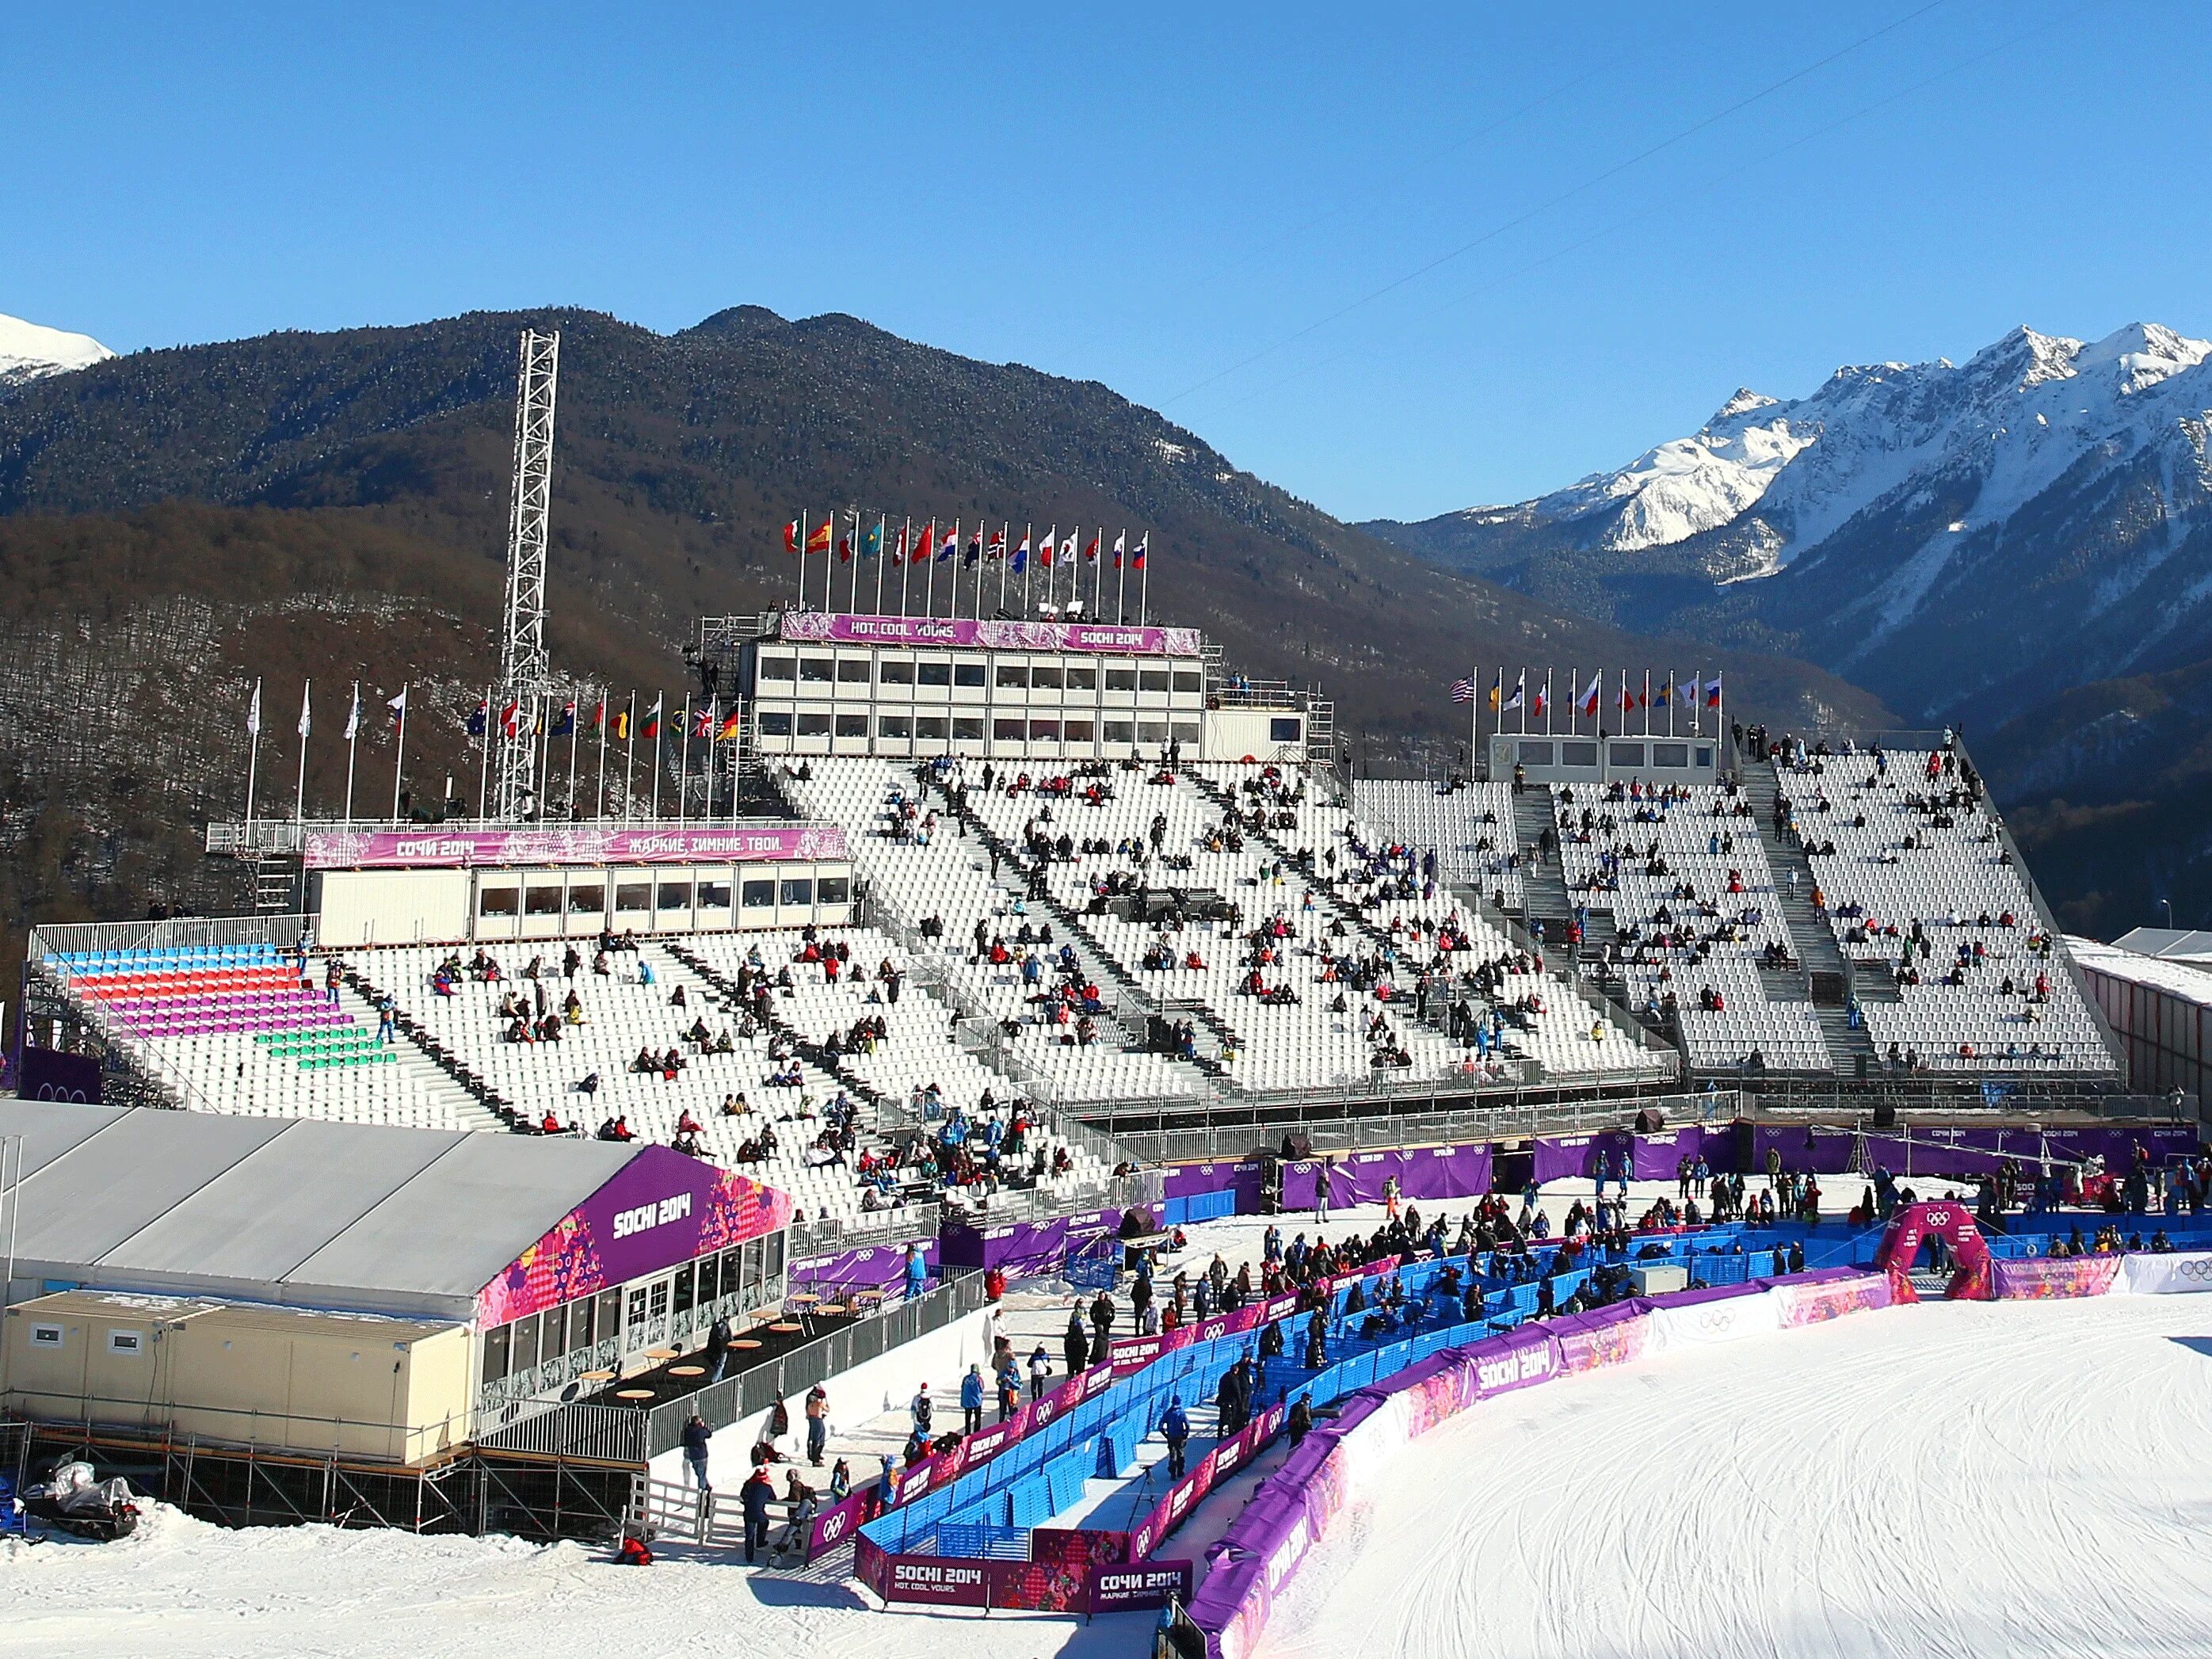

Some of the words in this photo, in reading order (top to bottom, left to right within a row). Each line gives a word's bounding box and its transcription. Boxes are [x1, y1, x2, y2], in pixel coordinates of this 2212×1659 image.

[851, 622, 876, 635] HOT.
[880, 624, 912, 636] COOL.
[916, 624, 956, 638] YOURS.
[1081, 631, 1113, 644] SOCHI
[1116, 633, 1142, 645] 2014
[397, 841, 437, 856] СОЧИ
[440, 840, 475, 856] 2014
[691, 837, 745, 852] ЗИМНИЕ.
[747, 837, 783, 851] ТВОИ.
[613, 1202, 657, 1240] SOCHI
[658, 1192, 692, 1226] 2014
[1112, 1345, 1139, 1360] SOCHI
[1139, 1342, 1160, 1356] 2014
[1478, 1358, 1520, 1390] SOCHI
[1520, 1348, 1550, 1379] 2014
[895, 1566, 941, 1582] SOCHI
[945, 1569, 982, 1585] 2014
[1100, 1574, 1142, 1590] СОЧИ
[1146, 1572, 1181, 1587] 2014
